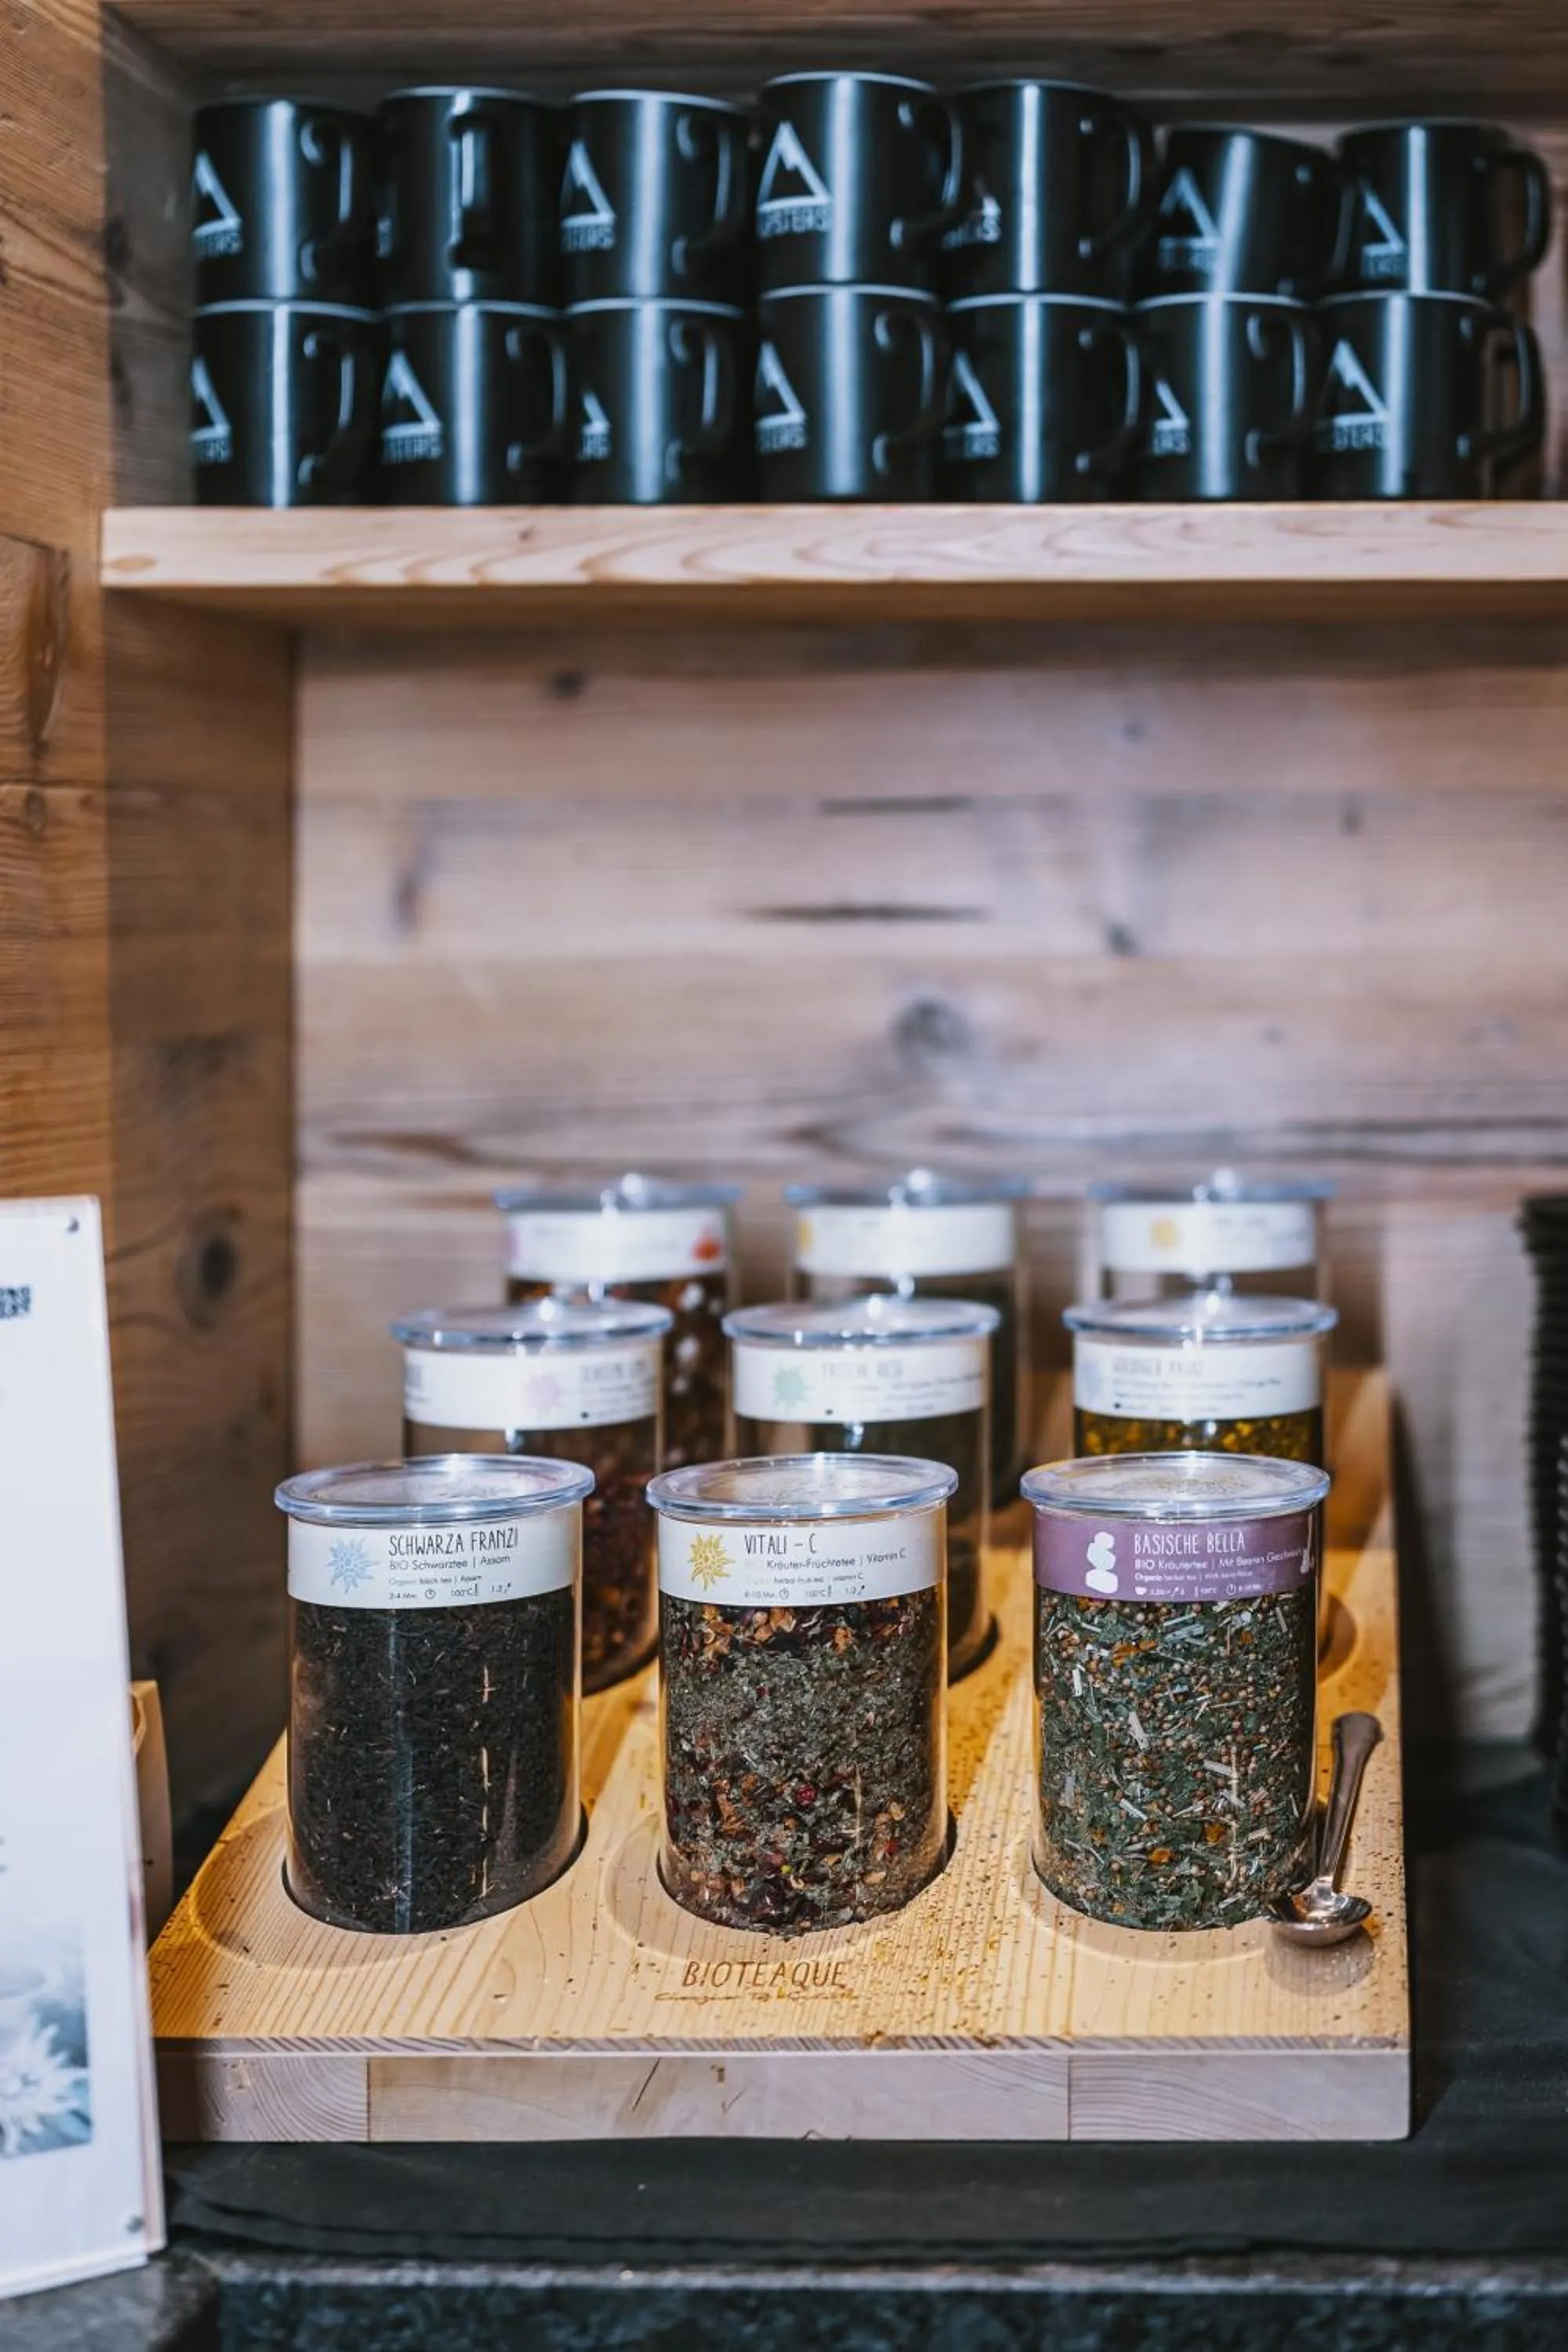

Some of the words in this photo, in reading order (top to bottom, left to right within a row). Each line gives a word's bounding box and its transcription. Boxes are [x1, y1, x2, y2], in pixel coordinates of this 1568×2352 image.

[389, 1533, 465, 1556] SCHWARZA
[470, 1527, 519, 1552] FRANZI
[744, 1534, 787, 1555] VITALI
[808, 1533, 817, 1554] C
[1134, 1533, 1200, 1555] BASISCHE
[1207, 1530, 1245, 1553] BELLA
[480, 1555, 510, 1566] Assam
[1134, 1559, 1155, 1570] BIO
[682, 1960, 848, 1990] BIOTEAQUE
